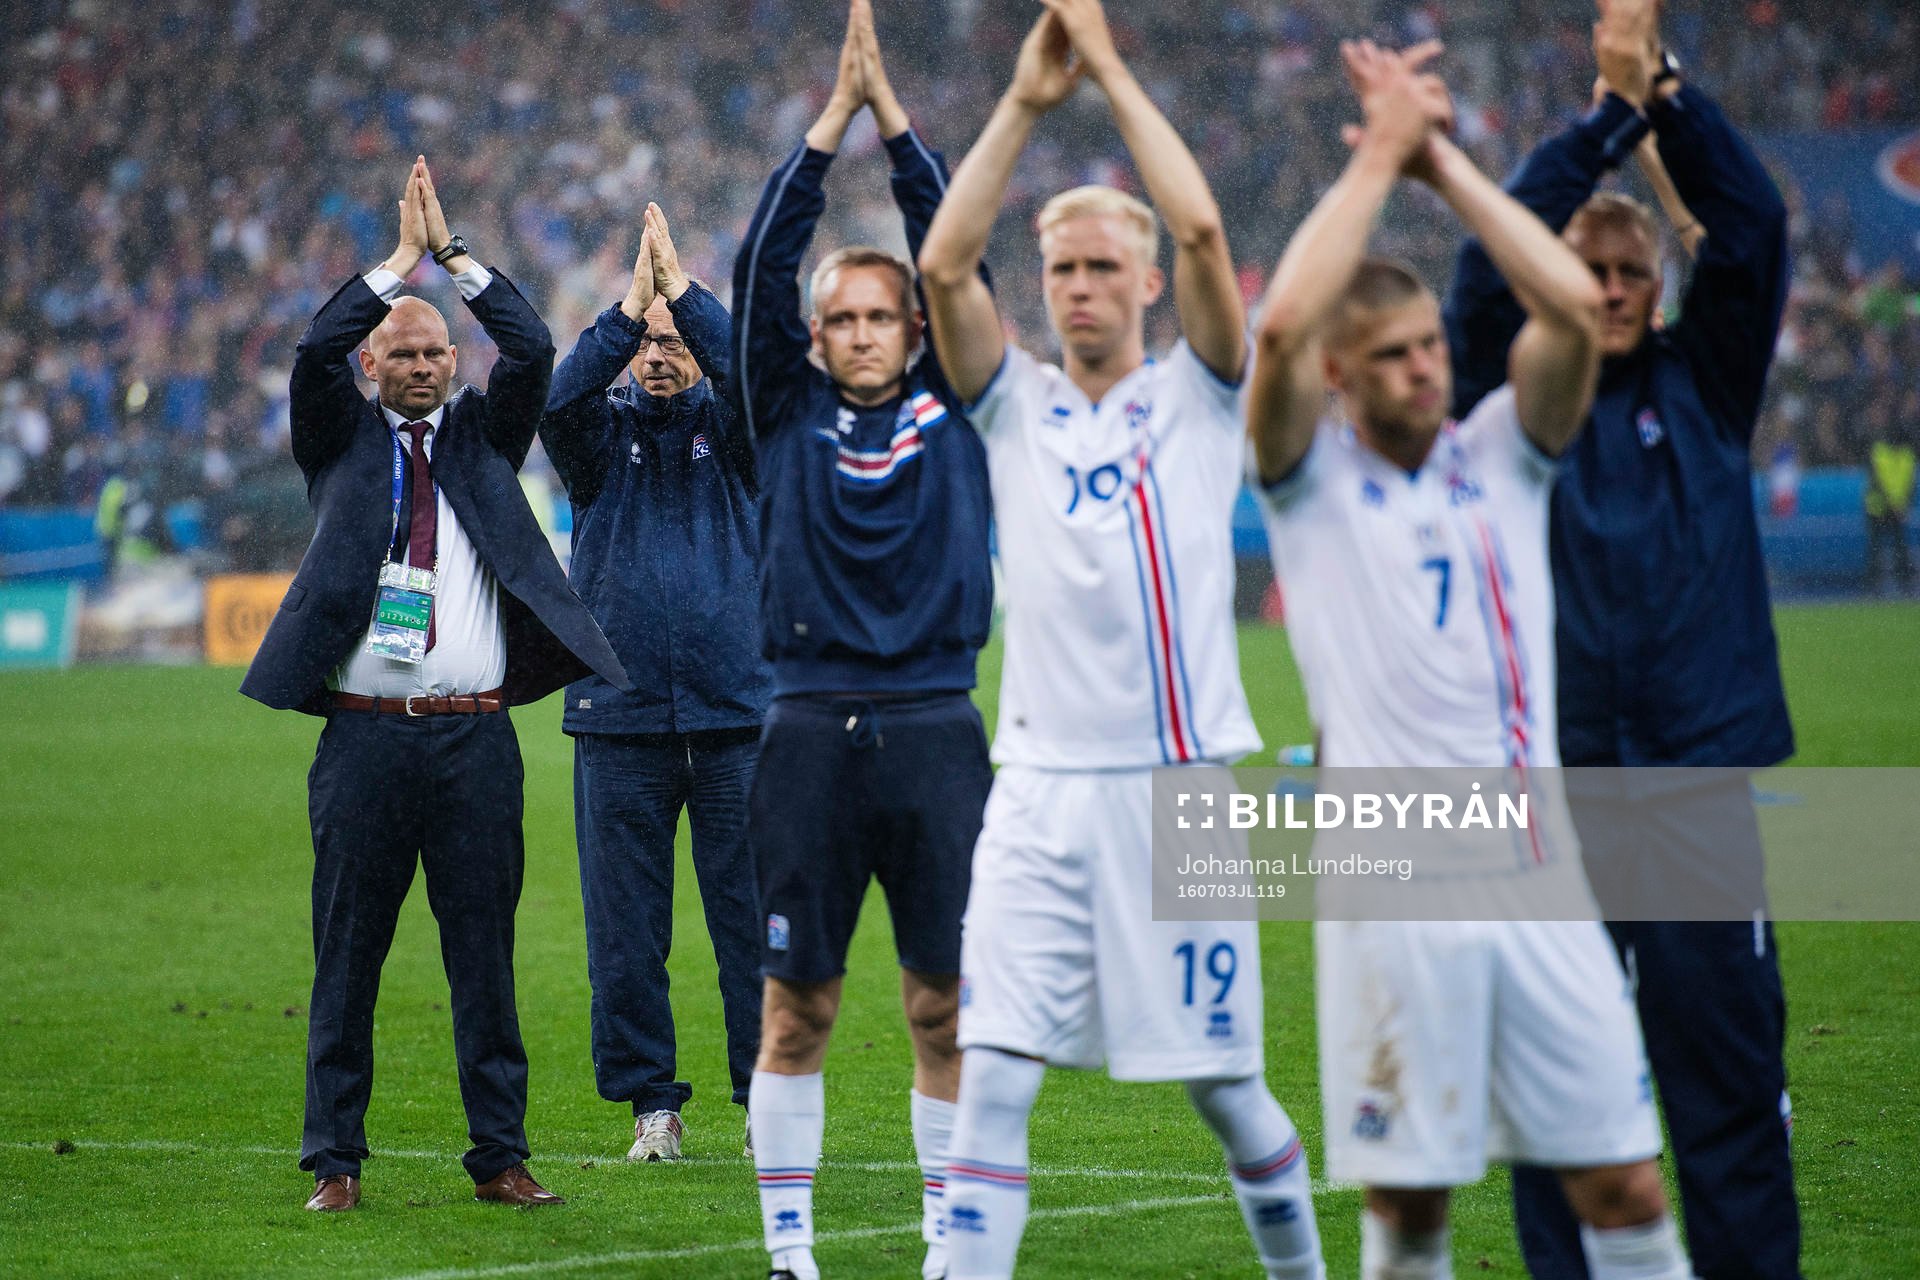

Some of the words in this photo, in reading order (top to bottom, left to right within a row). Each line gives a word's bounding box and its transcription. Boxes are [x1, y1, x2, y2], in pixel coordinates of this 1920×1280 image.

[394, 463, 402, 480] UEFA
[1420, 555, 1451, 629] 7
[1174, 941, 1237, 1006] 19
